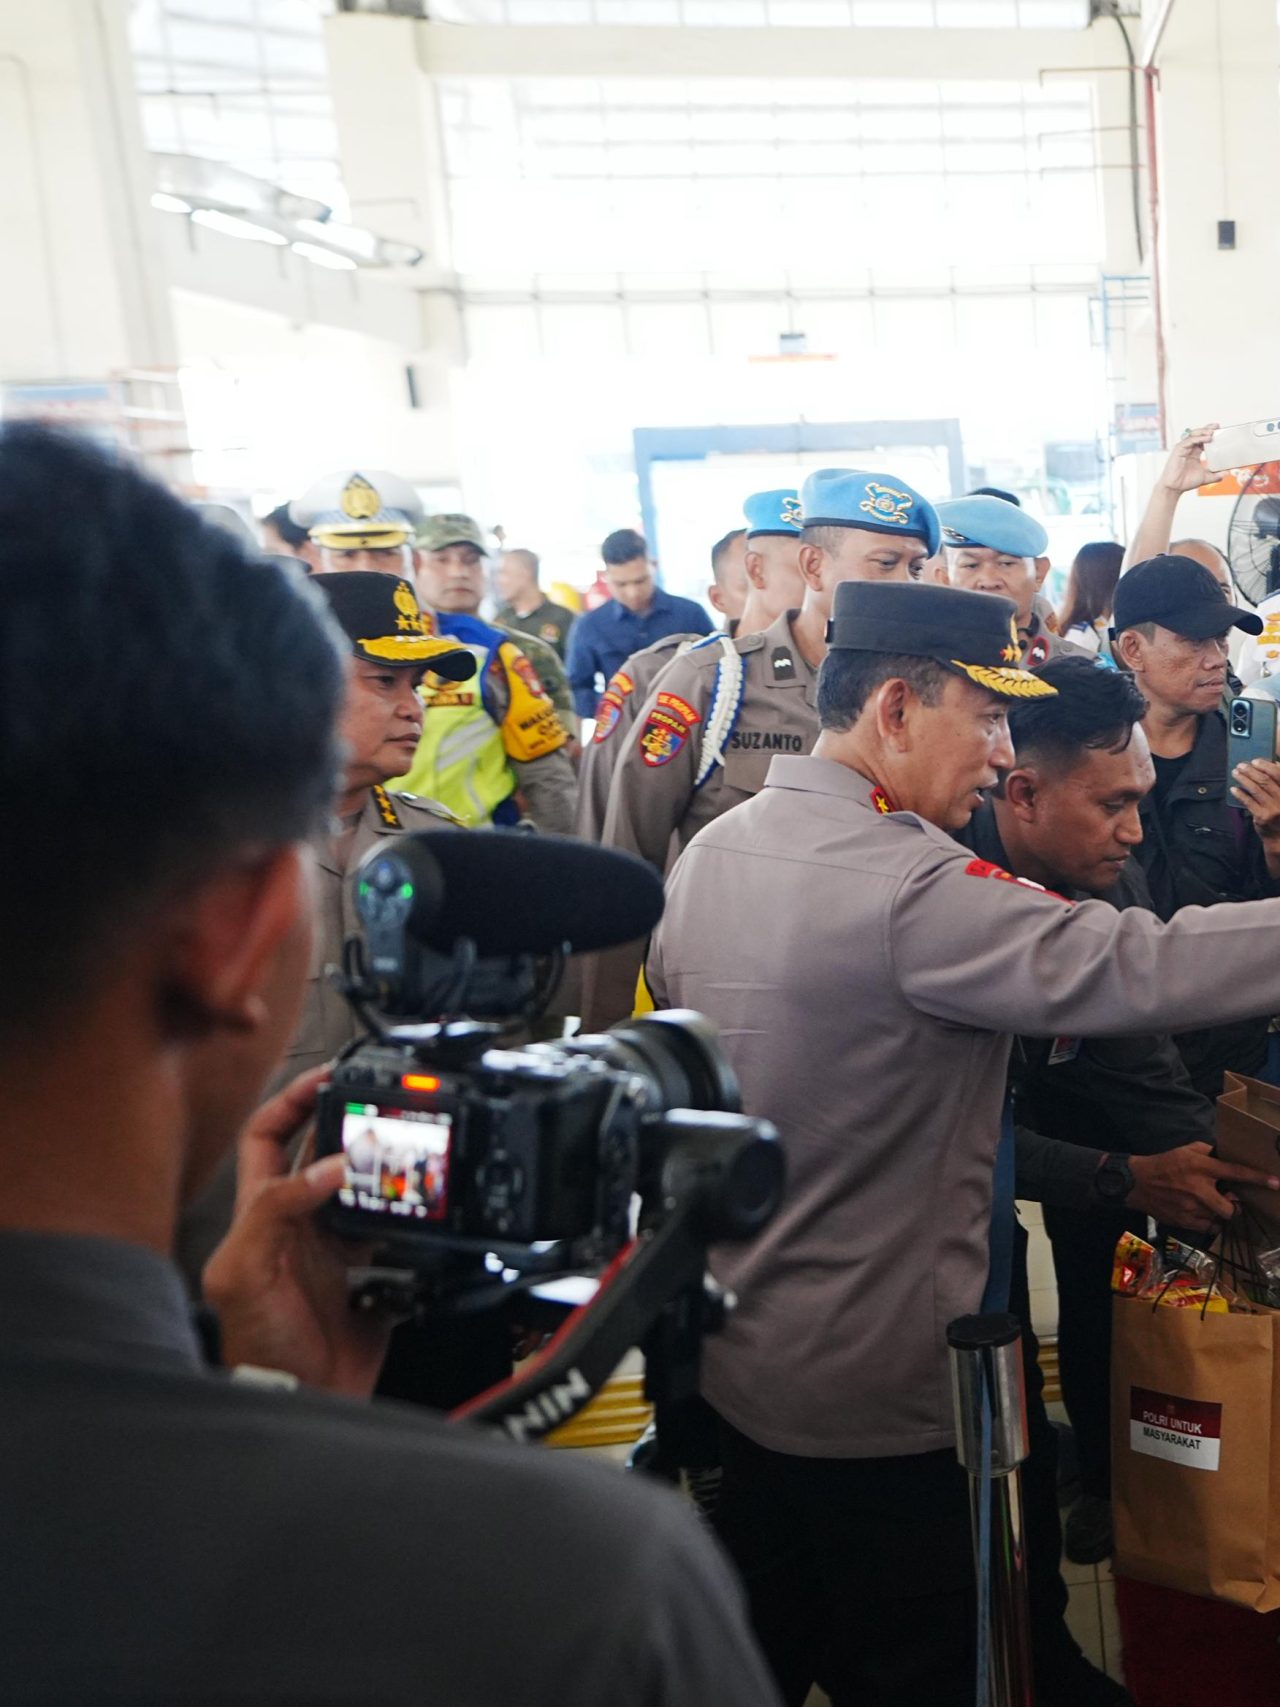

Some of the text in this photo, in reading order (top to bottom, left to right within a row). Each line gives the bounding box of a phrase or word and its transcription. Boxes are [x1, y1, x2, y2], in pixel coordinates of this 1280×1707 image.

[731, 731, 802, 751] SUZANTO
[1142, 1410, 1202, 1434] POLRI UNTUK
[1143, 1426, 1202, 1450] MASYARAKAT
